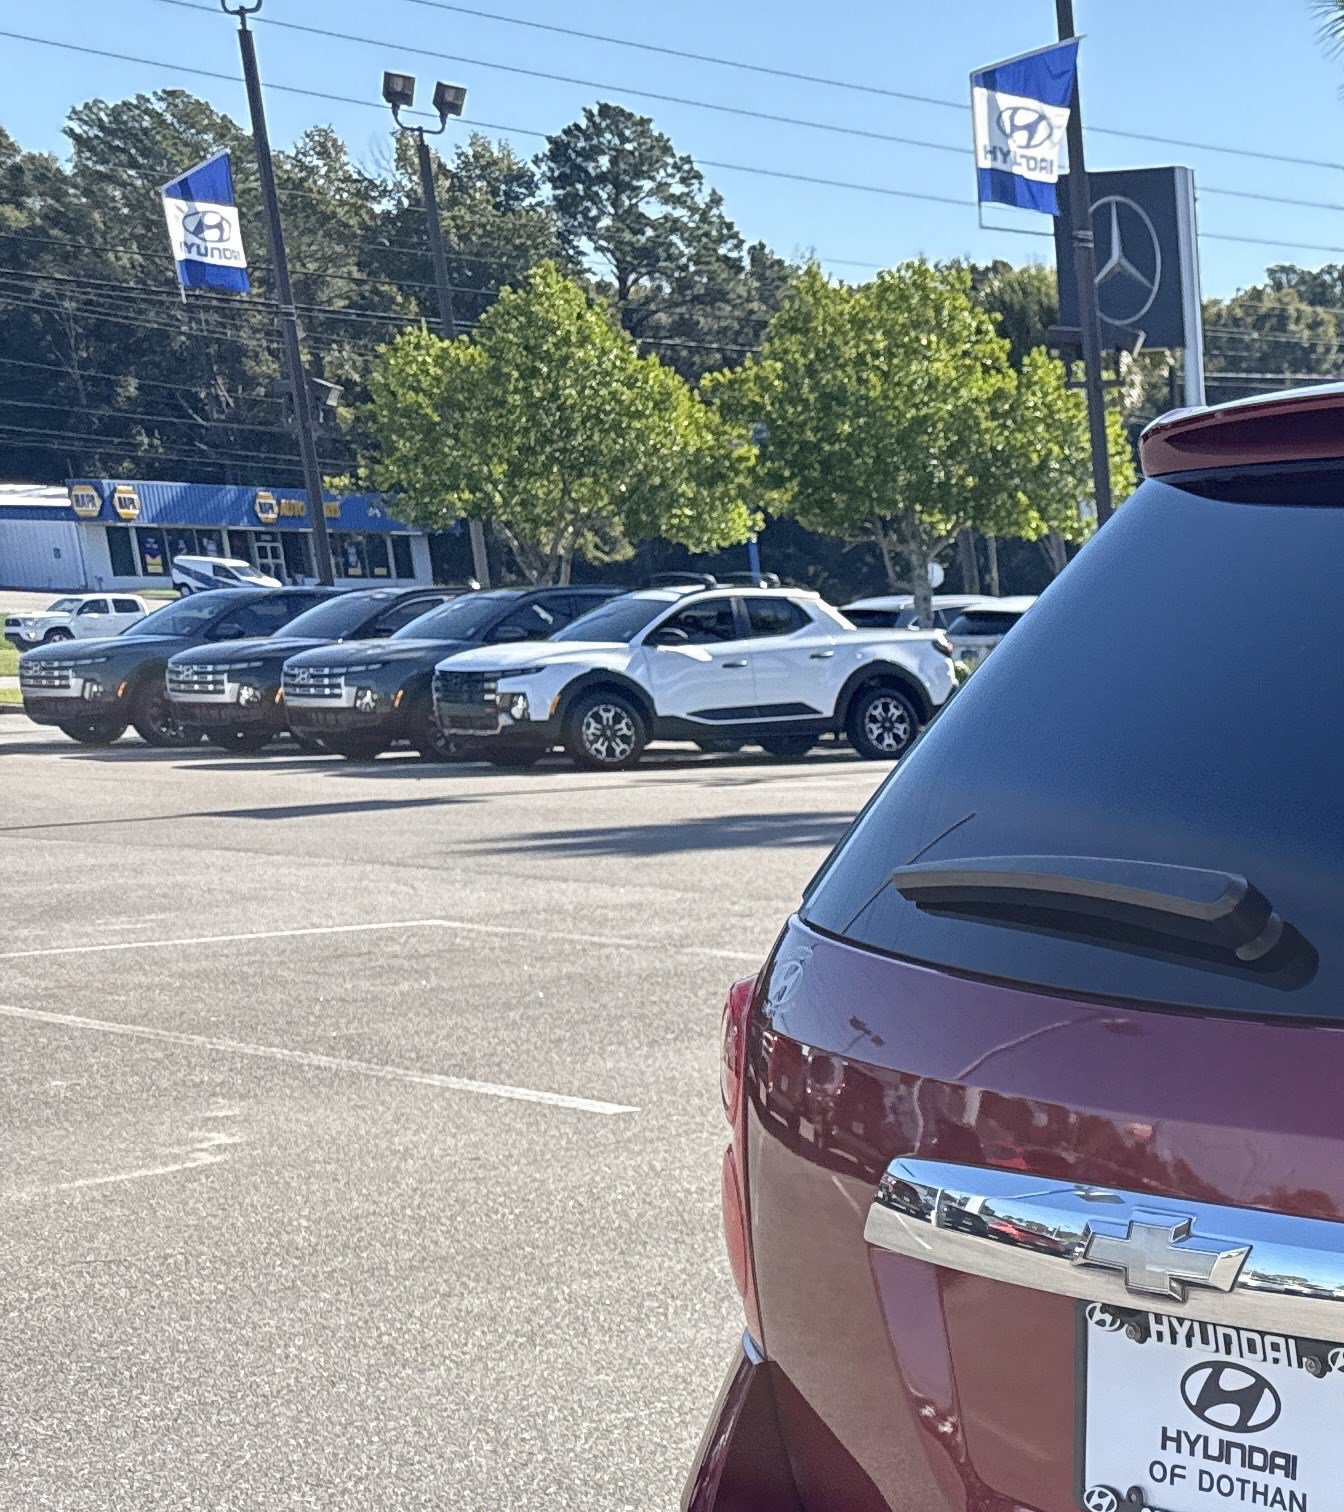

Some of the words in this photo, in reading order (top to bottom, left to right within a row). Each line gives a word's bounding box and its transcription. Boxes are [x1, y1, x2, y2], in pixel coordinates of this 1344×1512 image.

[1148, 1313, 1299, 1369] HYUNDAI
[1149, 1460, 1187, 1486] OF
[1160, 1426, 1298, 1480] HYUNDAI
